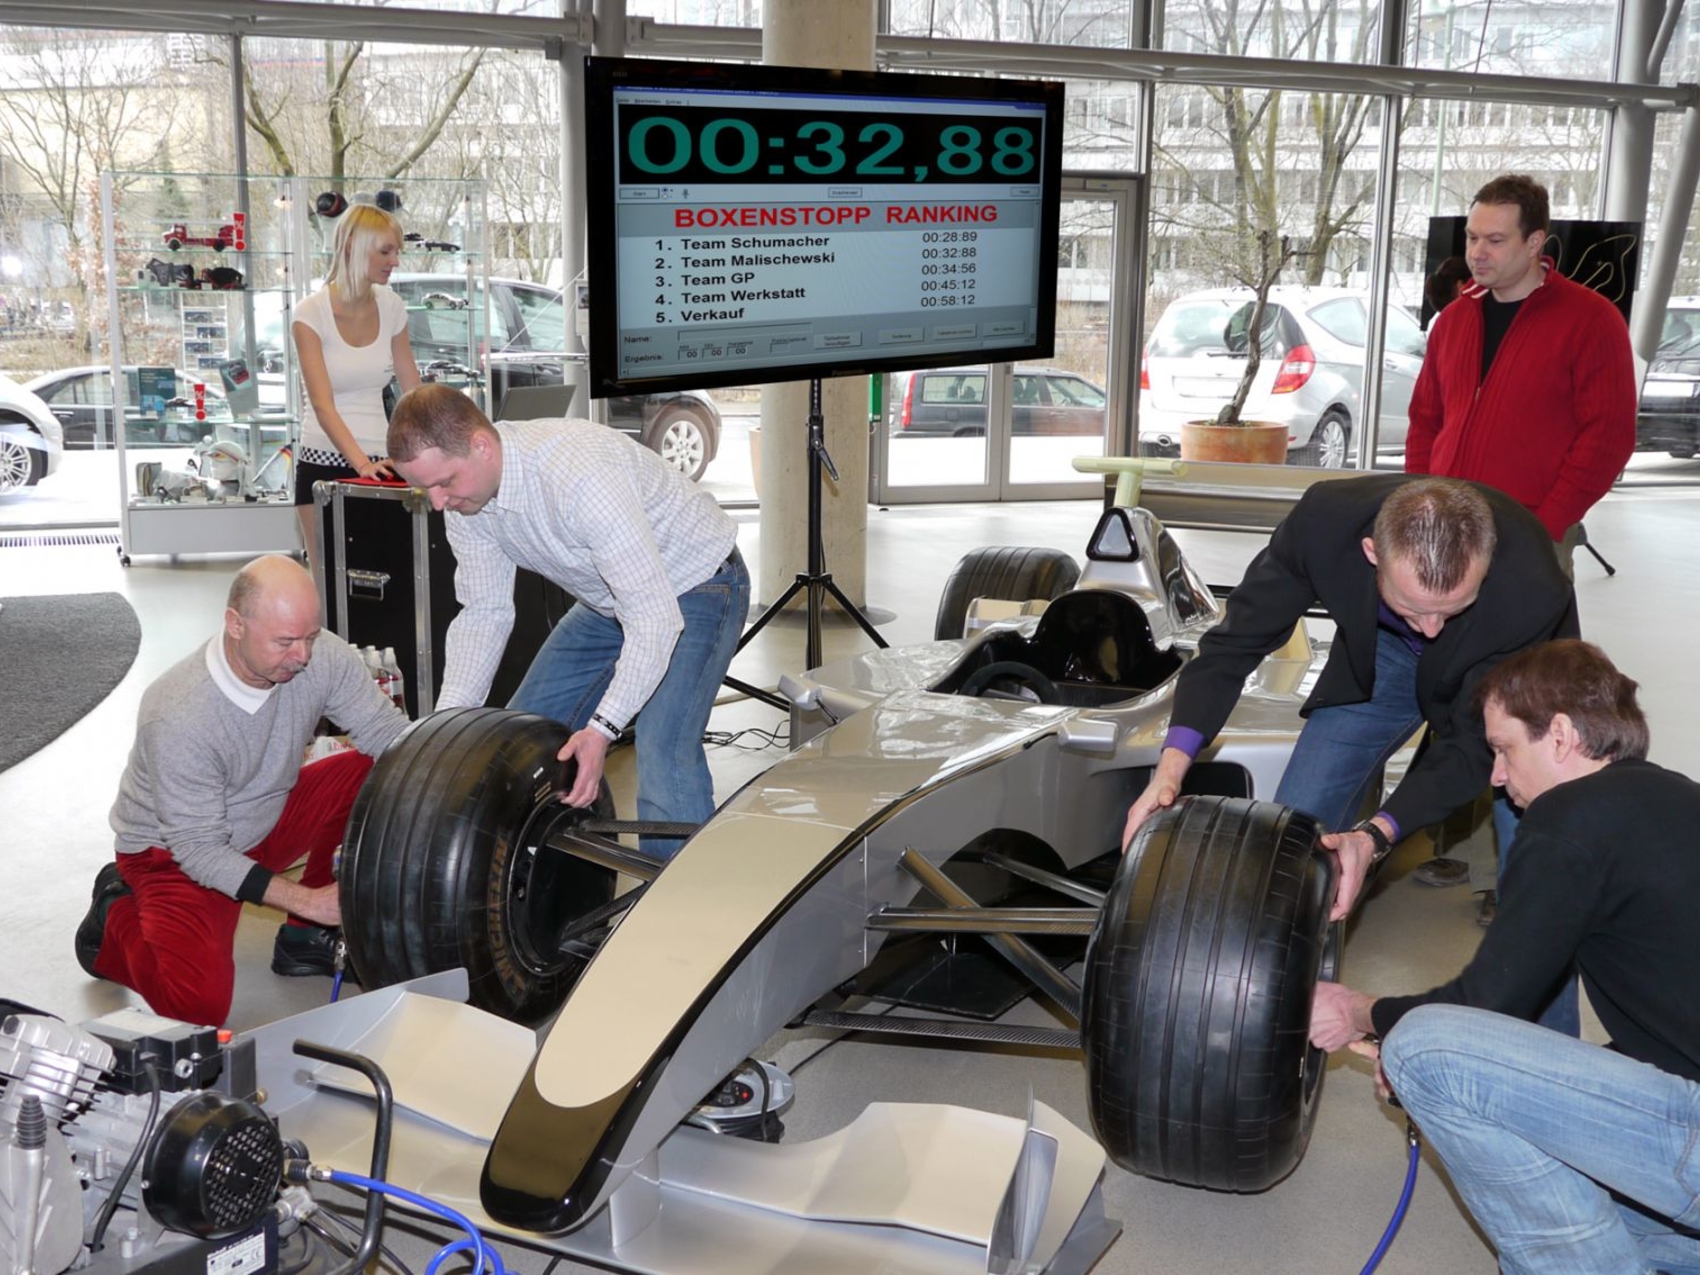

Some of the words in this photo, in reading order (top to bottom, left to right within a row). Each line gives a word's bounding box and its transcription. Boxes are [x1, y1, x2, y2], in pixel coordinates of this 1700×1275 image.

[628, 116, 1035, 181] 00:32,88
[674, 207, 871, 228] BOXENSTOPP
[886, 204, 998, 223] RANKING
[655, 238, 673, 251] 1.
[681, 237, 727, 250] Team
[730, 235, 830, 249] Schumacher
[922, 231, 978, 243] 00:28:89
[655, 257, 673, 269] 2.
[681, 256, 727, 268] Team
[730, 252, 836, 267] Malischewski
[921, 247, 977, 259] 00:32:88
[655, 276, 673, 288] 3.
[681, 274, 727, 286] Team
[730, 272, 756, 285] GP
[921, 263, 977, 275] 00:34:56
[655, 294, 673, 306] 4.
[681, 292, 727, 304] Team
[730, 287, 806, 302] Werkstatt
[920, 279, 976, 292] 00:45:12
[655, 312, 673, 324] 5.
[680, 307, 745, 322] Verkauf
[920, 294, 976, 308] 00:58:12
[488, 836, 515, 981] MICHELIN
